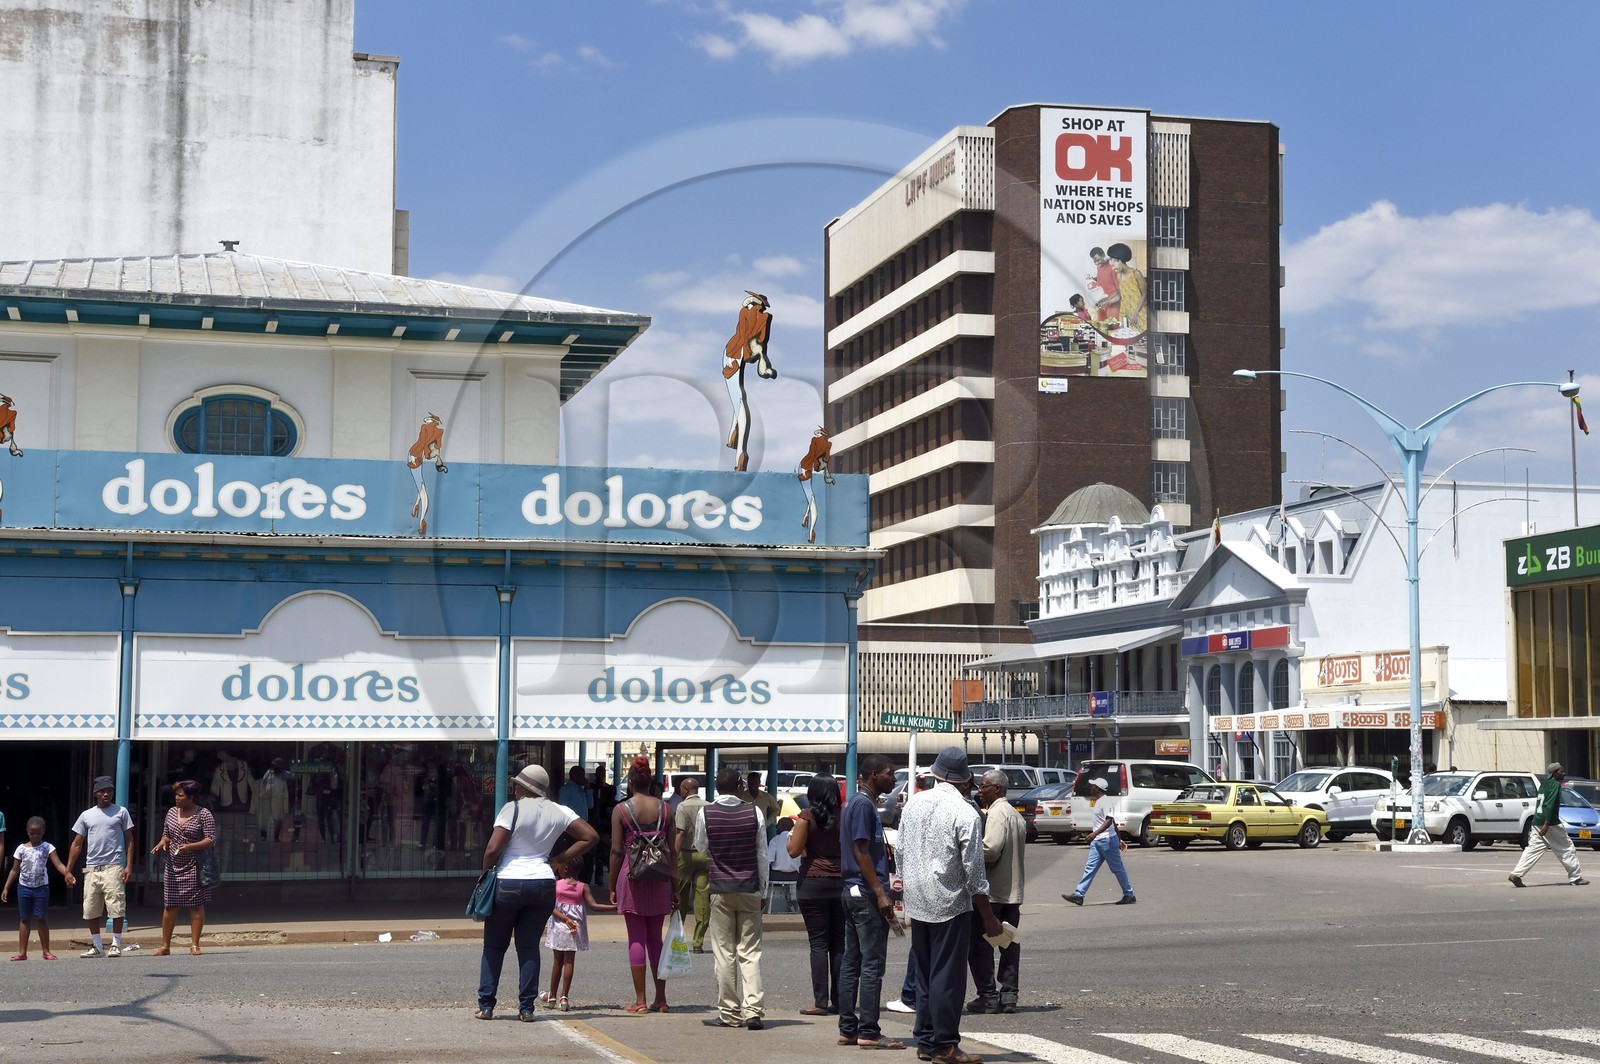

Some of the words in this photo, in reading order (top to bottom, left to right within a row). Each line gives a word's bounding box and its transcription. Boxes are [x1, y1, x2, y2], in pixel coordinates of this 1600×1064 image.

[1062, 118, 1103, 130] SHOP
[1107, 120, 1125, 132] AT
[1055, 133, 1132, 182] OK
[1056, 185, 1103, 197] WHERE
[1106, 187, 1132, 198] THE
[1043, 199, 1095, 210] NATION
[1099, 201, 1144, 212] SHOPS
[1056, 213, 1086, 224] AND
[1090, 214, 1132, 226] SAVES
[102, 459, 367, 520] dolores
[521, 473, 763, 531] dolores
[1546, 546, 1570, 571] ZB
[1326, 659, 1358, 684] BOOTS
[1384, 652, 1410, 682] BOOT
[221, 663, 419, 702] dolores
[587, 667, 772, 704] dolores
[908, 716, 934, 729] NKOMO
[938, 720, 948, 730] ST
[1350, 712, 1384, 726] BOOTS
[1402, 712, 1435, 726] BTS
[1536, 794, 1544, 814] 7
